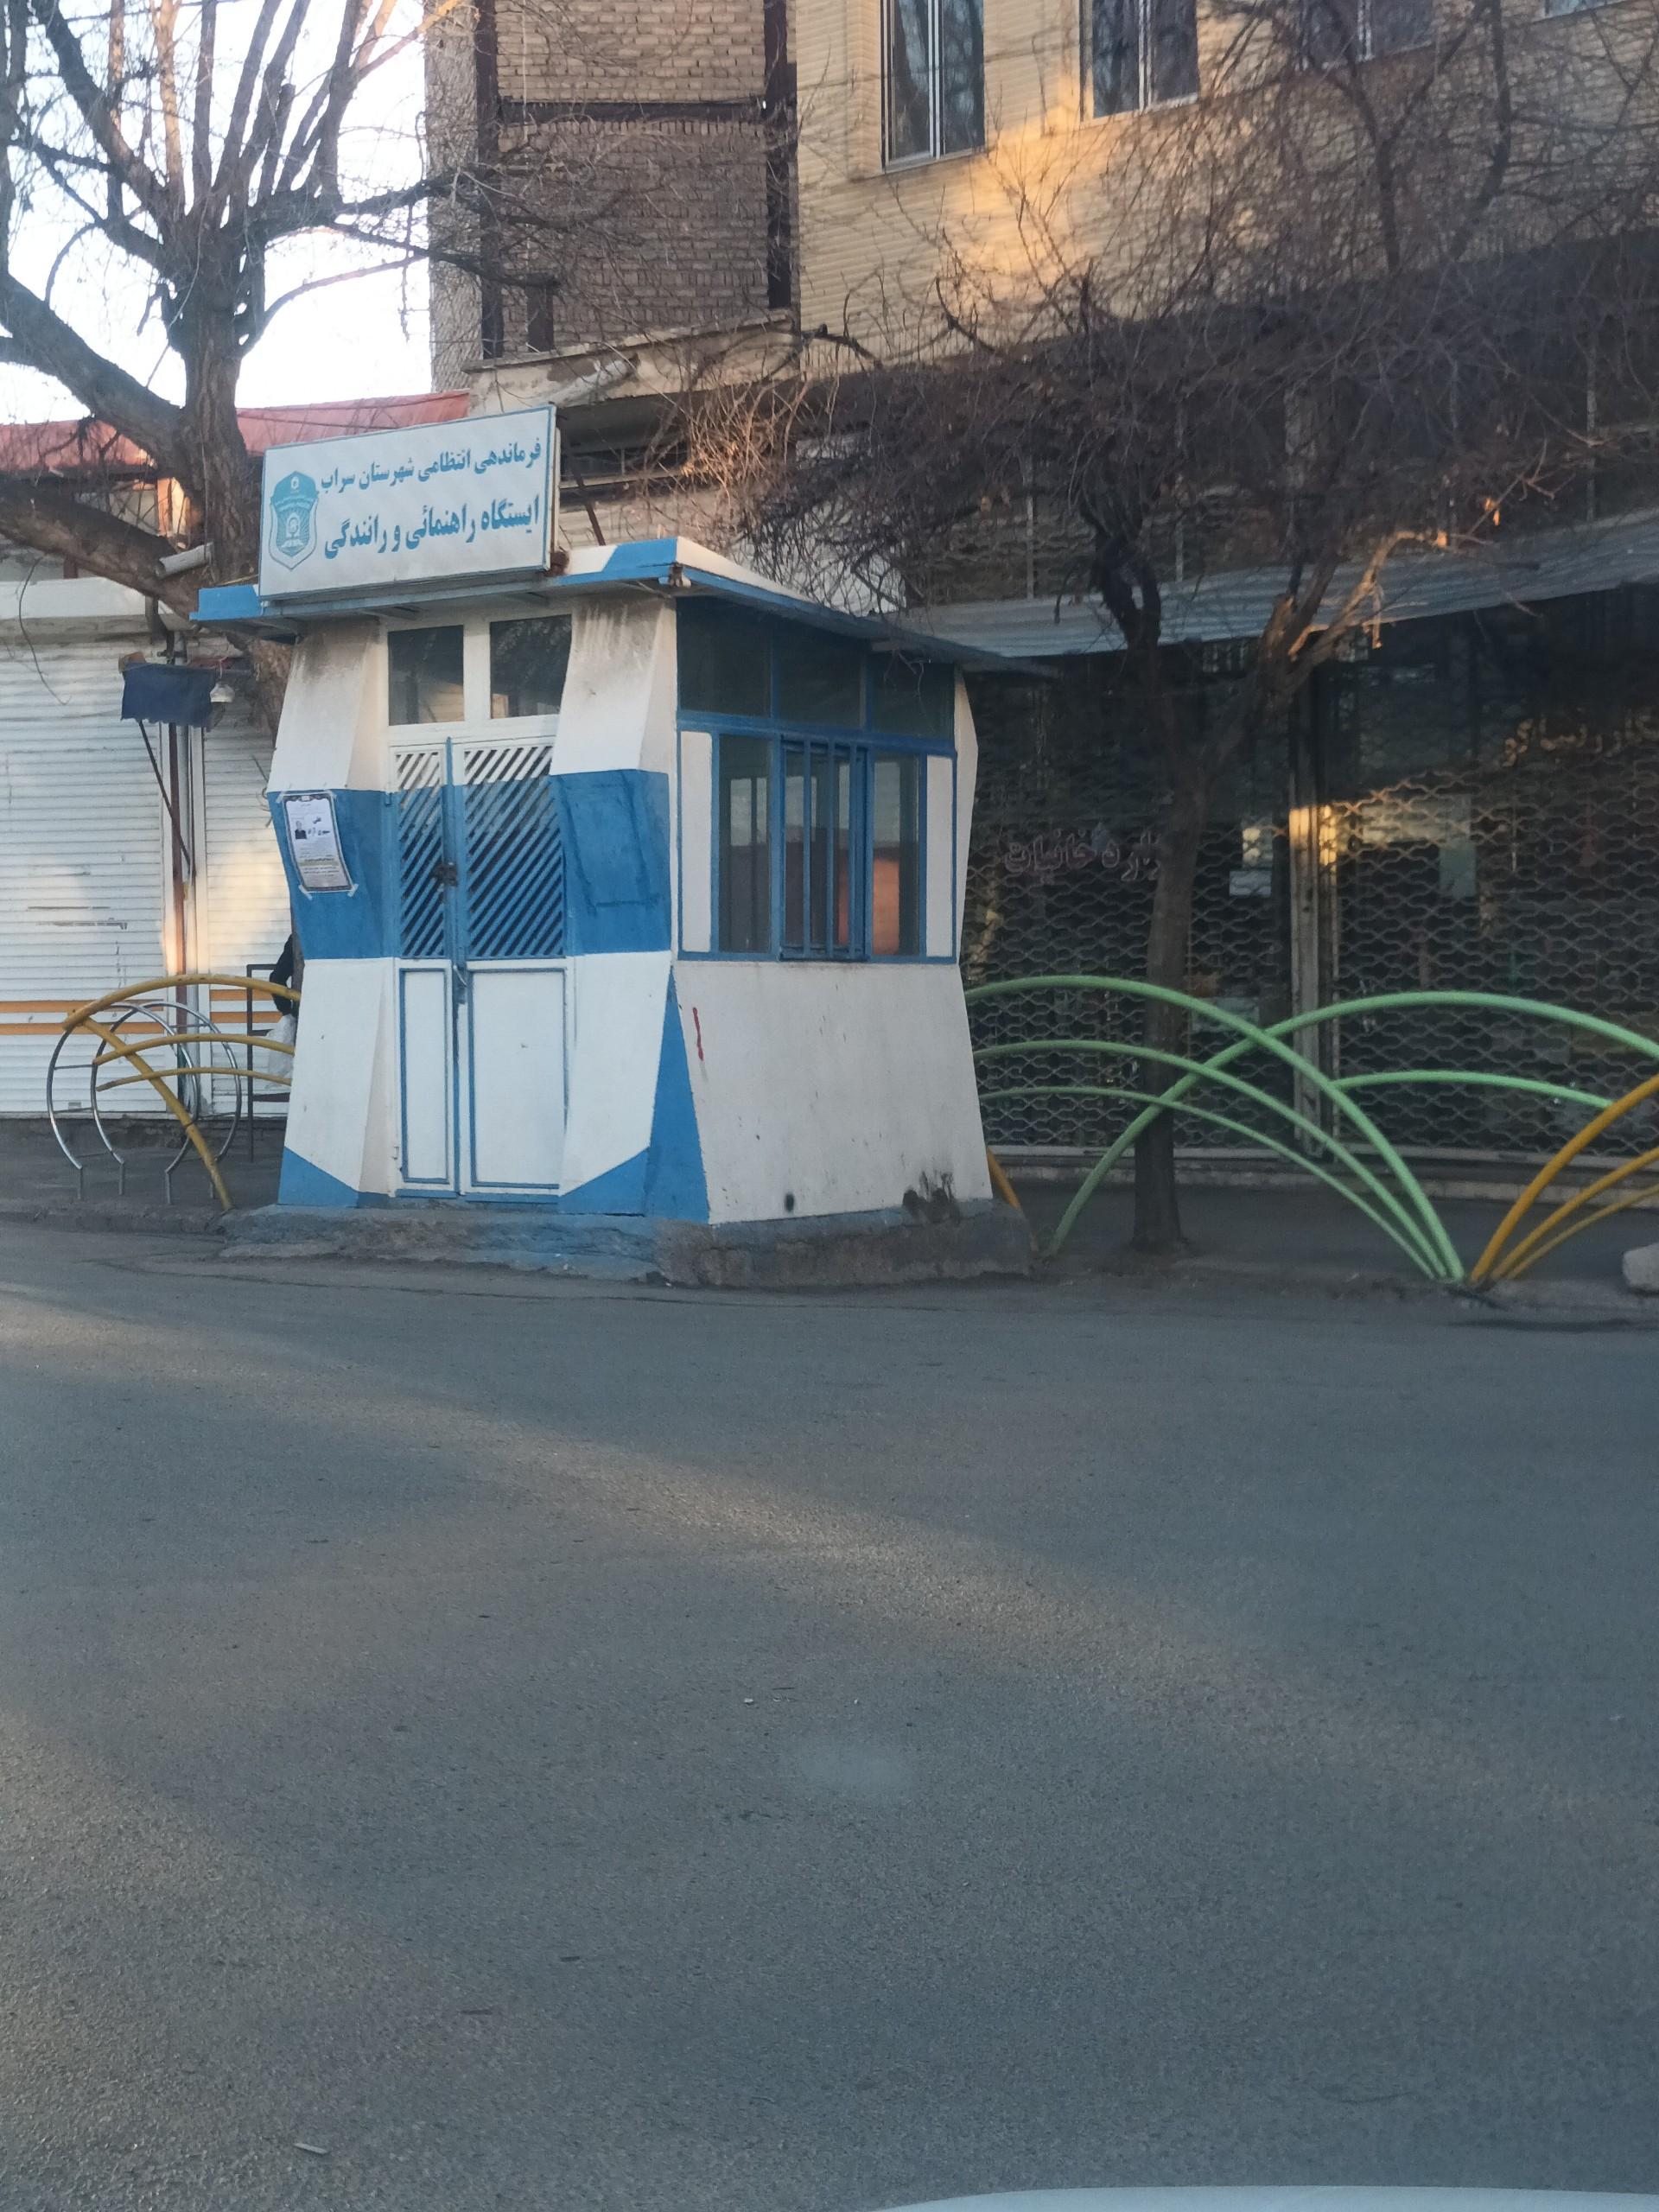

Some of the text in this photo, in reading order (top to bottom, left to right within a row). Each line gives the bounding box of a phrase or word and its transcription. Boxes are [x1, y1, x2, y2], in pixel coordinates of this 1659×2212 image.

[321, 437, 541, 493] فرماندهی انتظامی شهرستان سراب
[480, 493, 539, 534] ایستگاه
[325, 513, 387, 560] رانندگی
[391, 524, 401, 552] و
